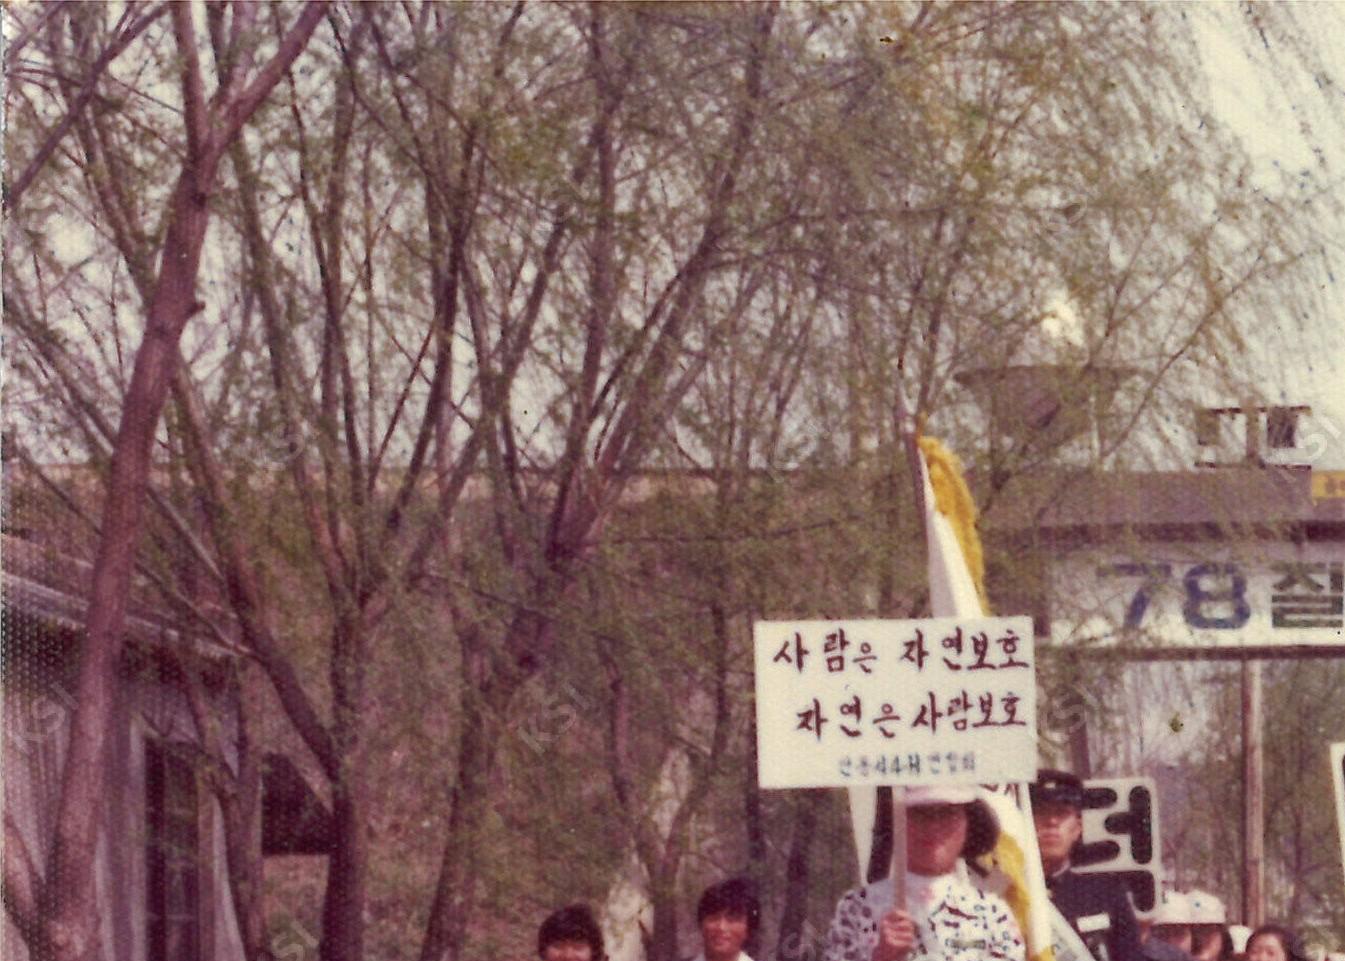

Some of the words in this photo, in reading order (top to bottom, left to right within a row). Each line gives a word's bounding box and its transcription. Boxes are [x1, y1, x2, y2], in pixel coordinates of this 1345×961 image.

[773, 628, 878, 674] 사람은
[900, 626, 1030, 673] 자연보호
[796, 694, 901, 742] 자연은
[911, 689, 1027, 735] 사람보호
